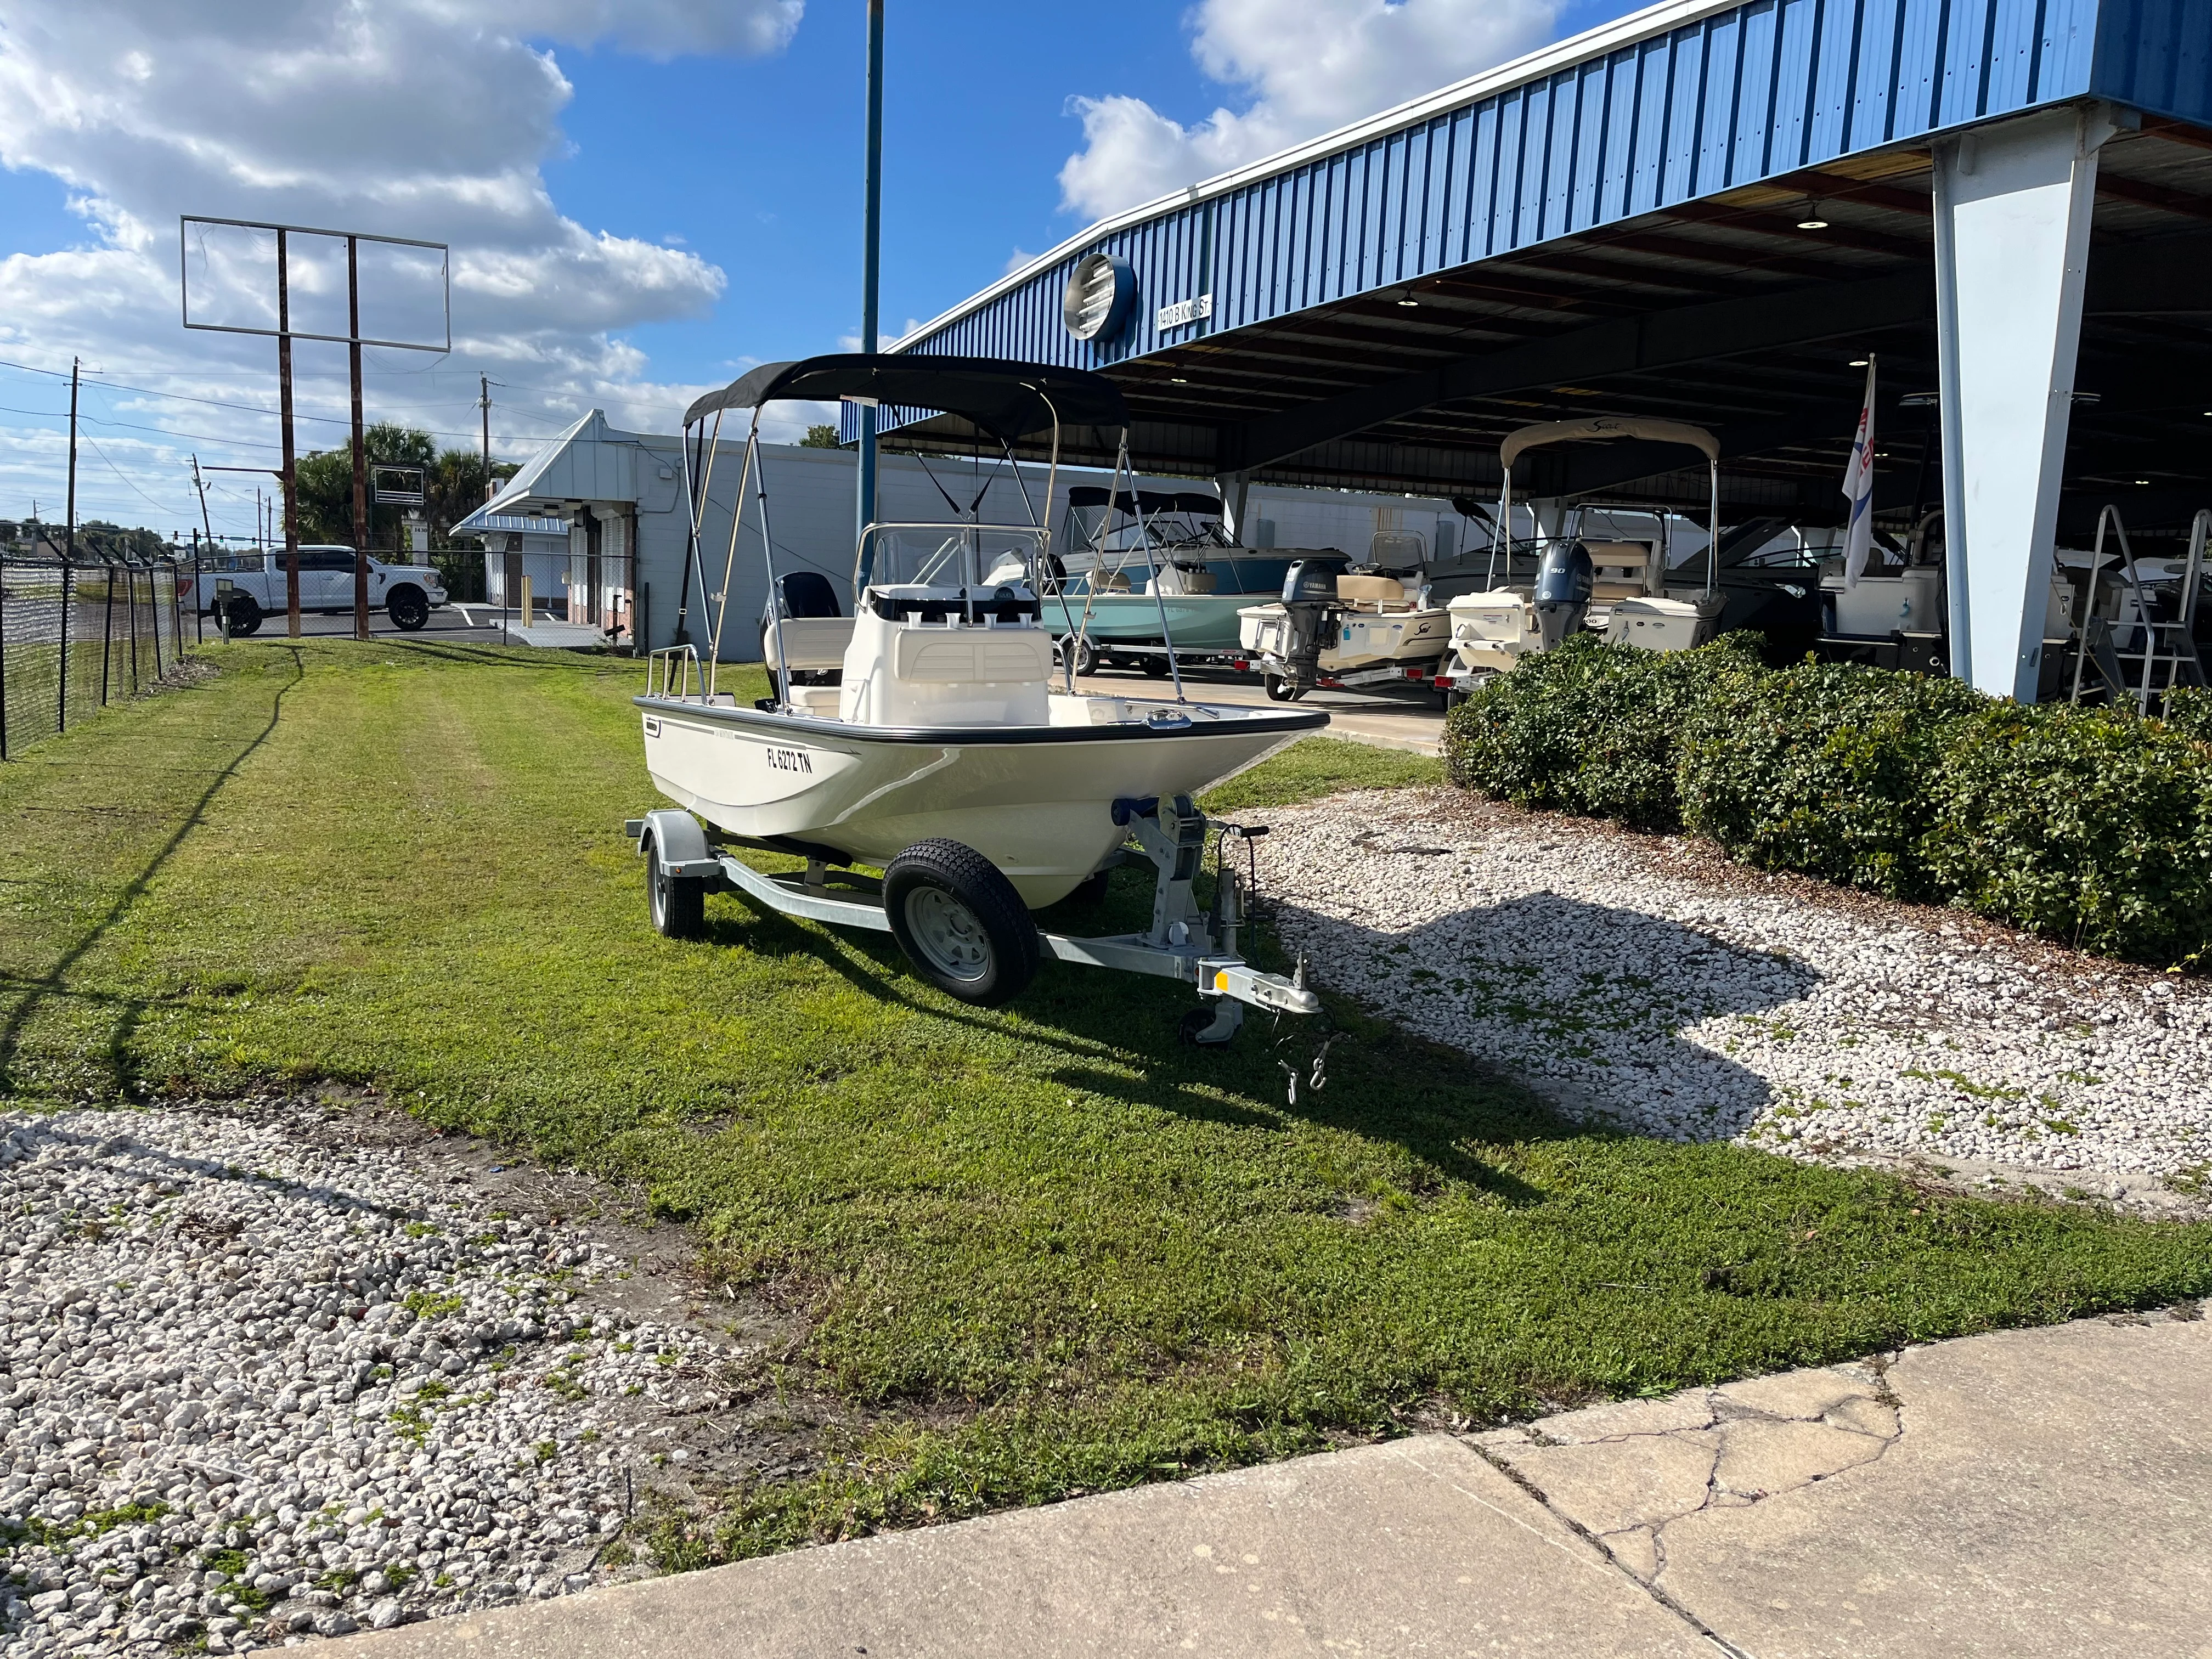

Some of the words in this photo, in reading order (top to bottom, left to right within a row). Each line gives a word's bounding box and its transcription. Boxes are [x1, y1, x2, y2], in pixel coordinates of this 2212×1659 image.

[1160, 308, 1173, 327] 1410
[1175, 307, 1179, 323] B
[1182, 304, 1197, 320] KING
[768, 748, 777, 768] FL
[778, 749, 798, 771] 6272
[797, 752, 812, 774] TN
